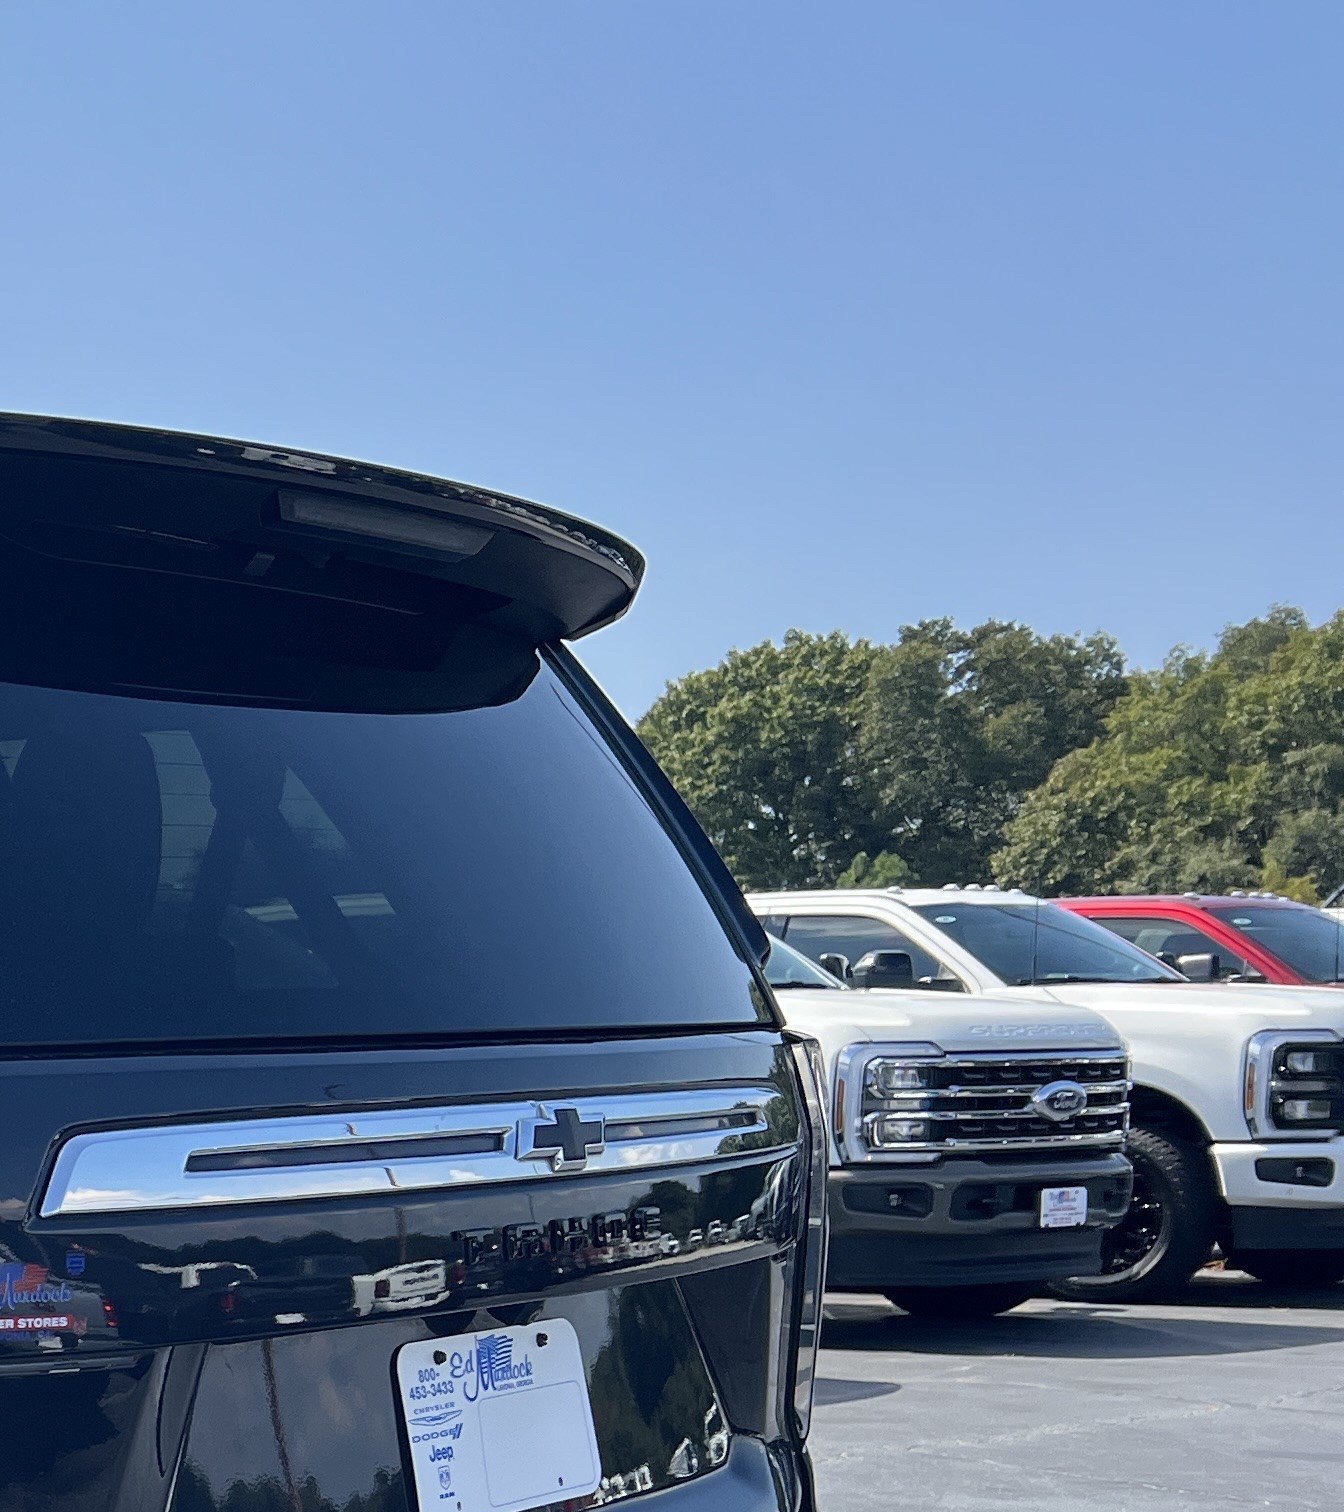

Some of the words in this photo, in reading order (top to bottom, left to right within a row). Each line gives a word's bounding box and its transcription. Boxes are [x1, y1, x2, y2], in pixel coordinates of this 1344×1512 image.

[450, 1206, 661, 1265] TAHOE
[17, 1316, 68, 1329] STORES
[417, 1367, 440, 1383] 800-
[450, 1350, 474, 1379] Ed
[463, 1345, 533, 1402] Murdock
[409, 1380, 454, 1400] 453-3433
[413, 1401, 455, 1415] CHRYSLER
[412, 1427, 457, 1443] DODGE
[429, 1445, 454, 1462] Jeep
